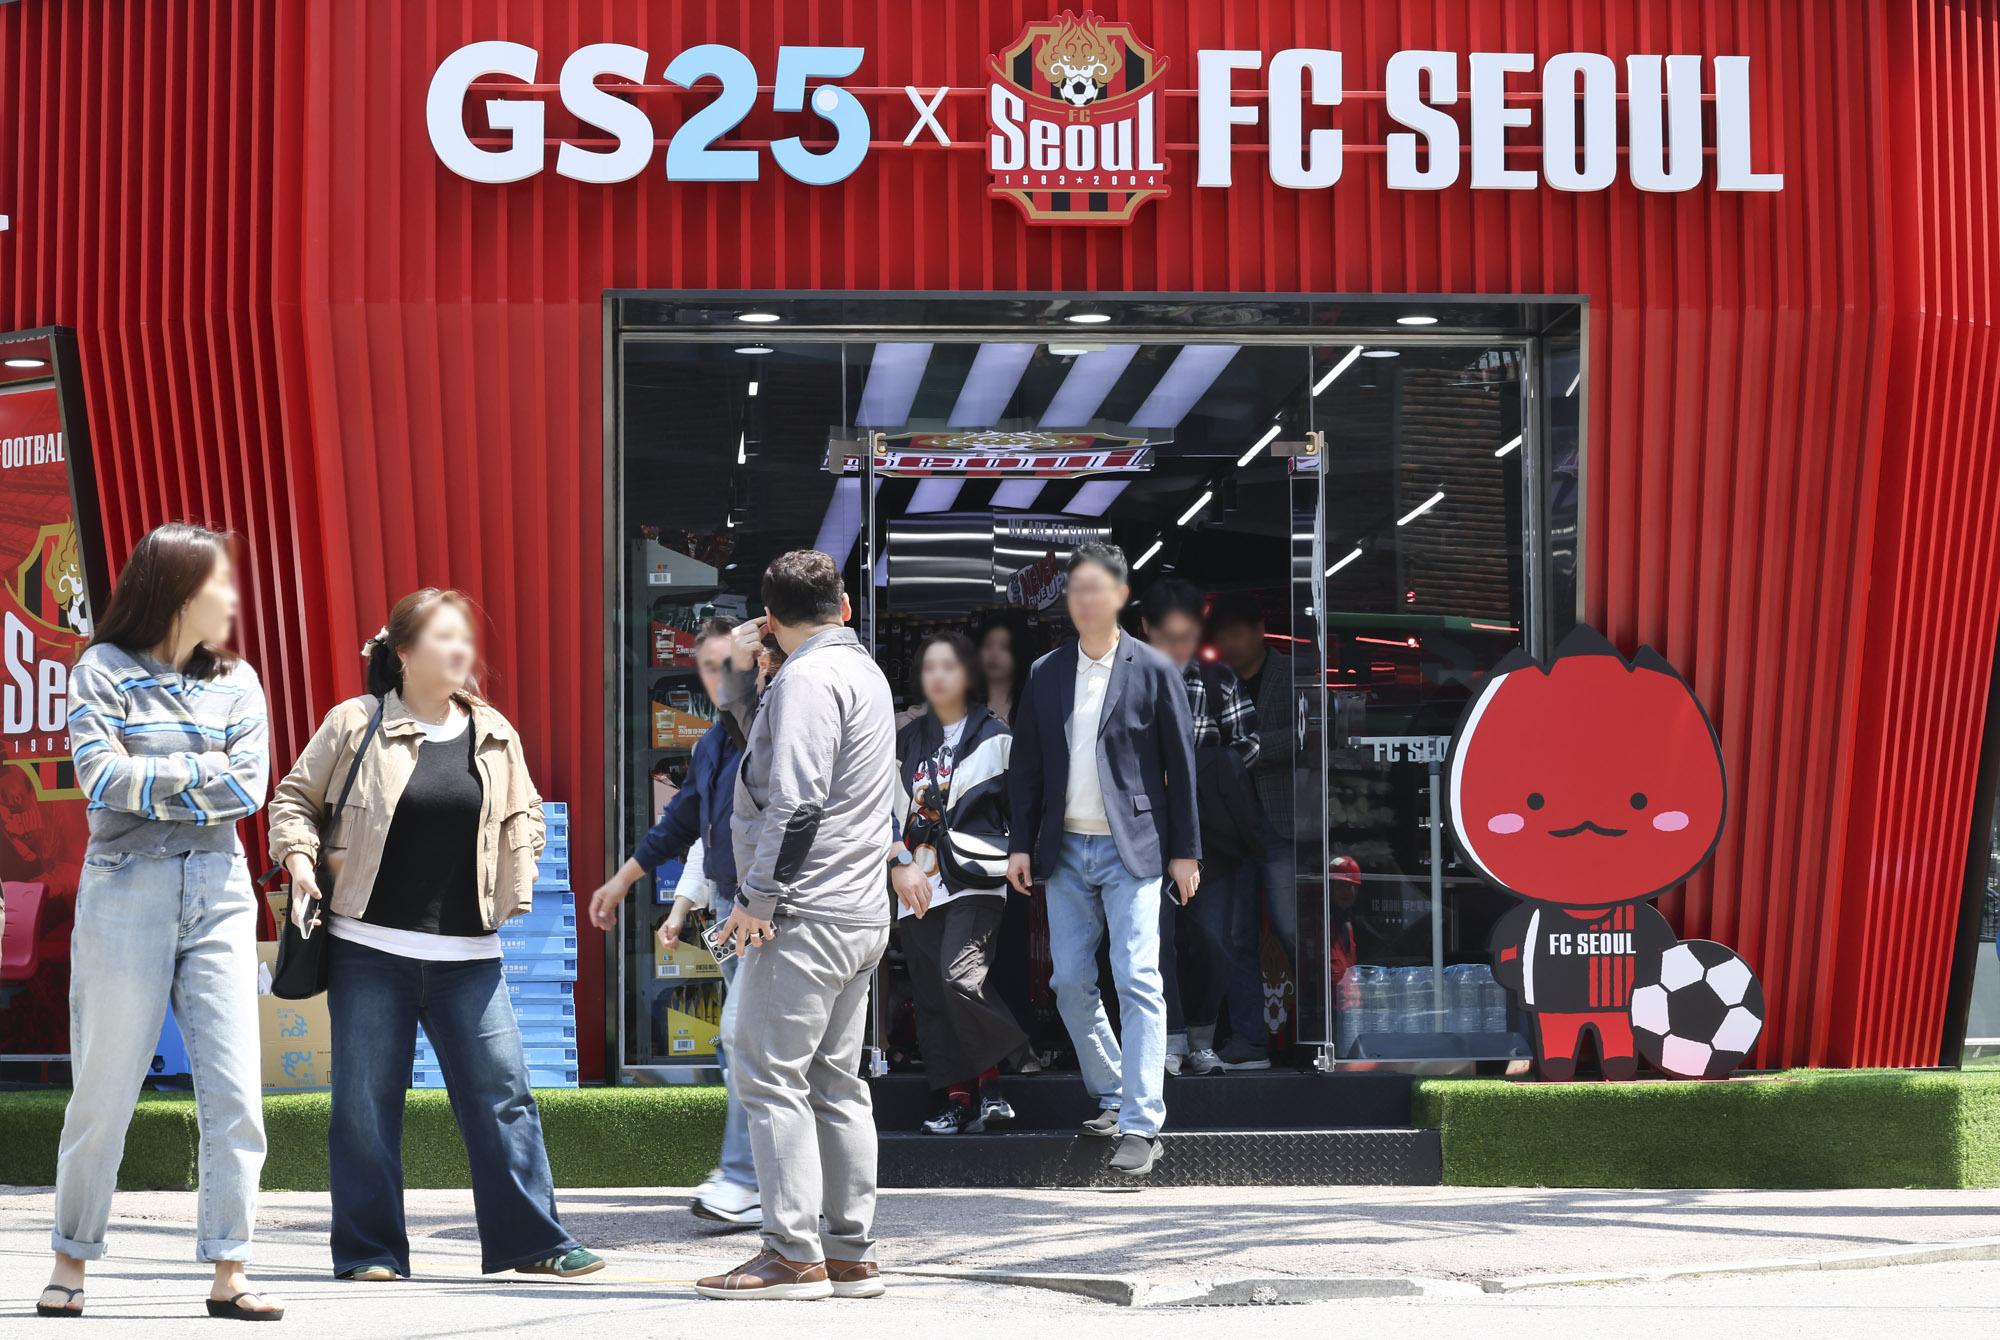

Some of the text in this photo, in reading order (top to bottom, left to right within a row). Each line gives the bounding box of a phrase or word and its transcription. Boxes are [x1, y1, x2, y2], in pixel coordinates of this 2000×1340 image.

[426, 41, 870, 185] GS25
[1197, 49, 1343, 190] FC
[1386, 50, 1784, 193] SEOUL
[1068, 109, 1091, 123] FC
[0, 431, 65, 469] OOTBAL
[1008, 519, 1025, 538] WE
[1027, 521, 1048, 542] ARE
[1052, 523, 1064, 544] FC
[1046, 571, 1065, 600] UP
[3, 610, 67, 734] Se
[1374, 738, 1450, 762] FC SEO
[1549, 933, 1636, 955] FC SEOUL
